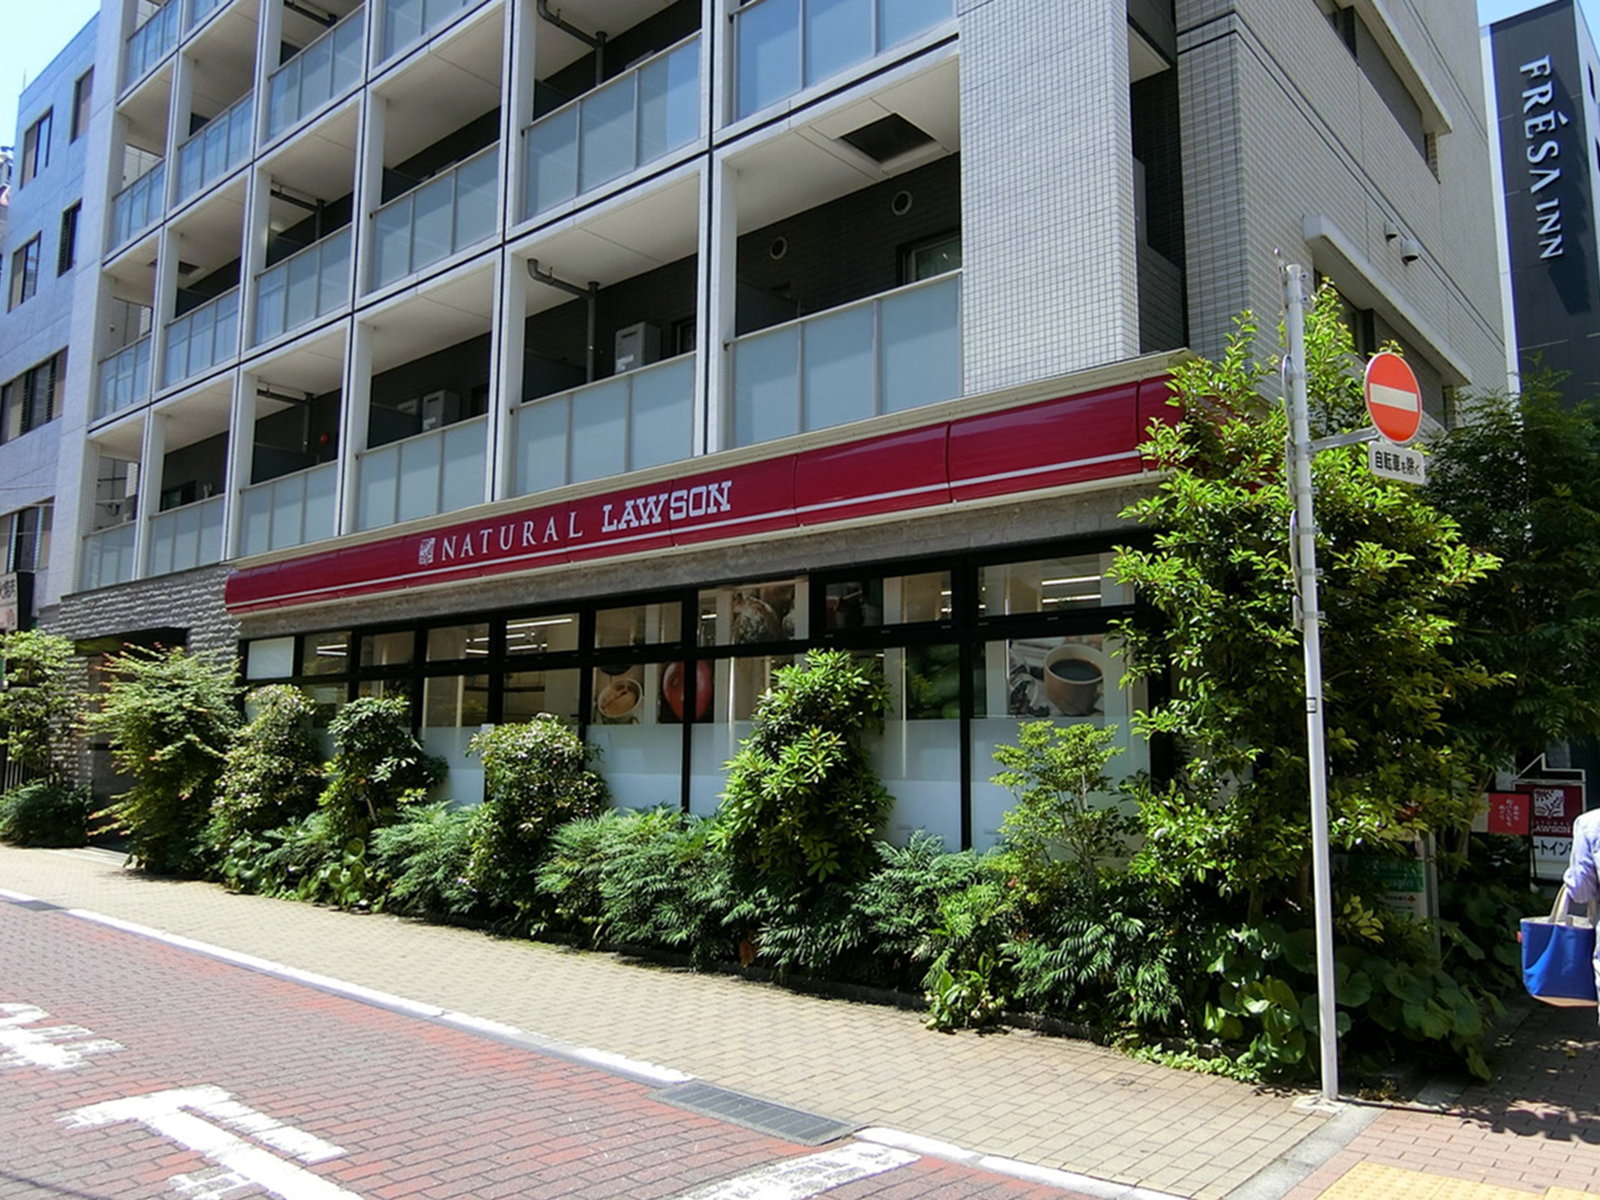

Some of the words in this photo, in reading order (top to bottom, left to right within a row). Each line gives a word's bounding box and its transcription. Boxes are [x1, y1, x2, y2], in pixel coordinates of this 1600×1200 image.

[1535, 198, 1564, 259] INN
[1375, 450, 1421, 476] 自転車を除く
[440, 511, 583, 561] NATURAL
[601, 480, 732, 533] LAWSON
